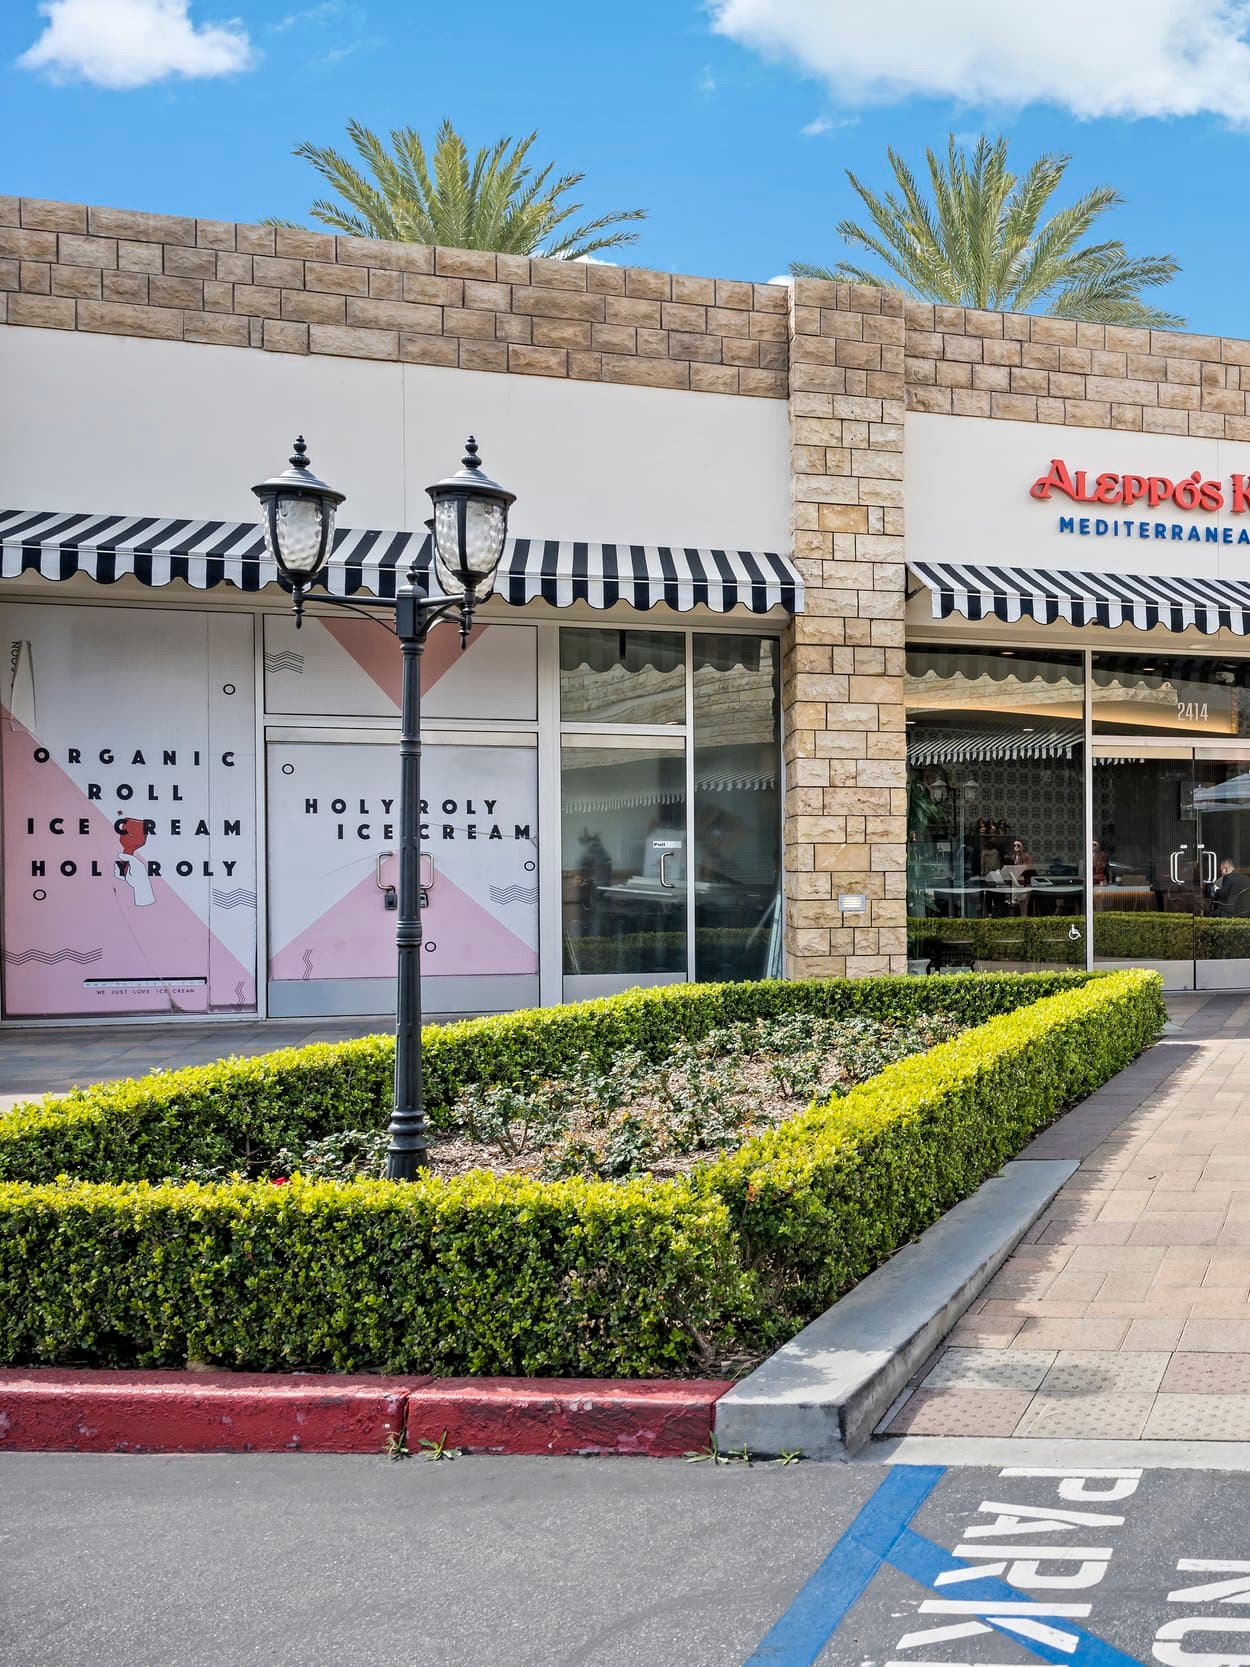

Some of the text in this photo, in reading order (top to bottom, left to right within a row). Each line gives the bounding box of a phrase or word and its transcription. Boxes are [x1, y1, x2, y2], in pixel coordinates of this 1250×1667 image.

[1177, 702, 1209, 721] 2414
[33, 747, 235, 767] ORGANIC
[88, 783, 183, 801] ROLL
[305, 799, 497, 815] HOLY ROLY
[26, 818, 241, 836] ICE CREAM
[337, 823, 531, 840] ICE CREAM
[31, 860, 237, 877] HOLY ROLY
